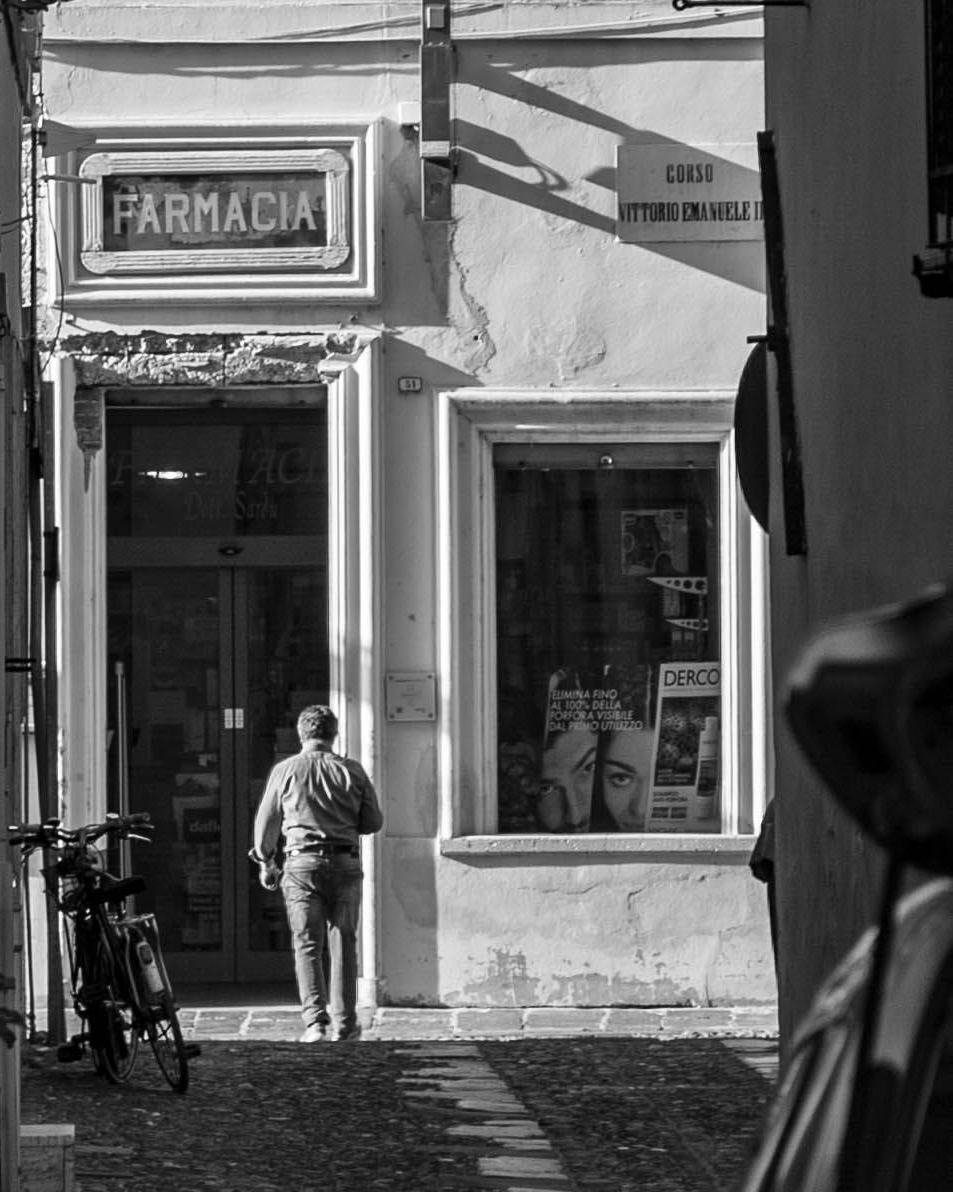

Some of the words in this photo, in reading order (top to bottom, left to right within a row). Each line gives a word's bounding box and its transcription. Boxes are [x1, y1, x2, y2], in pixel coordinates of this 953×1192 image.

[666, 163, 714, 184] CORSO
[112, 190, 318, 235] FARMACIA
[618, 201, 679, 223] VITTORIO
[682, 200, 751, 222] EMANUELE
[663, 668, 720, 687] DERCO
[552, 689, 590, 700] ELIMINA
[592, 689, 618, 700] FINO
[550, 700, 562, 710] AL
[565, 699, 590, 710] 100%
[592, 700, 622, 710] DELLA
[549, 710, 594, 721] FORFORA
[597, 710, 634, 720] VISIBILE
[549, 721, 566, 732] DAL
[600, 720, 643, 731] UTILIZZO
